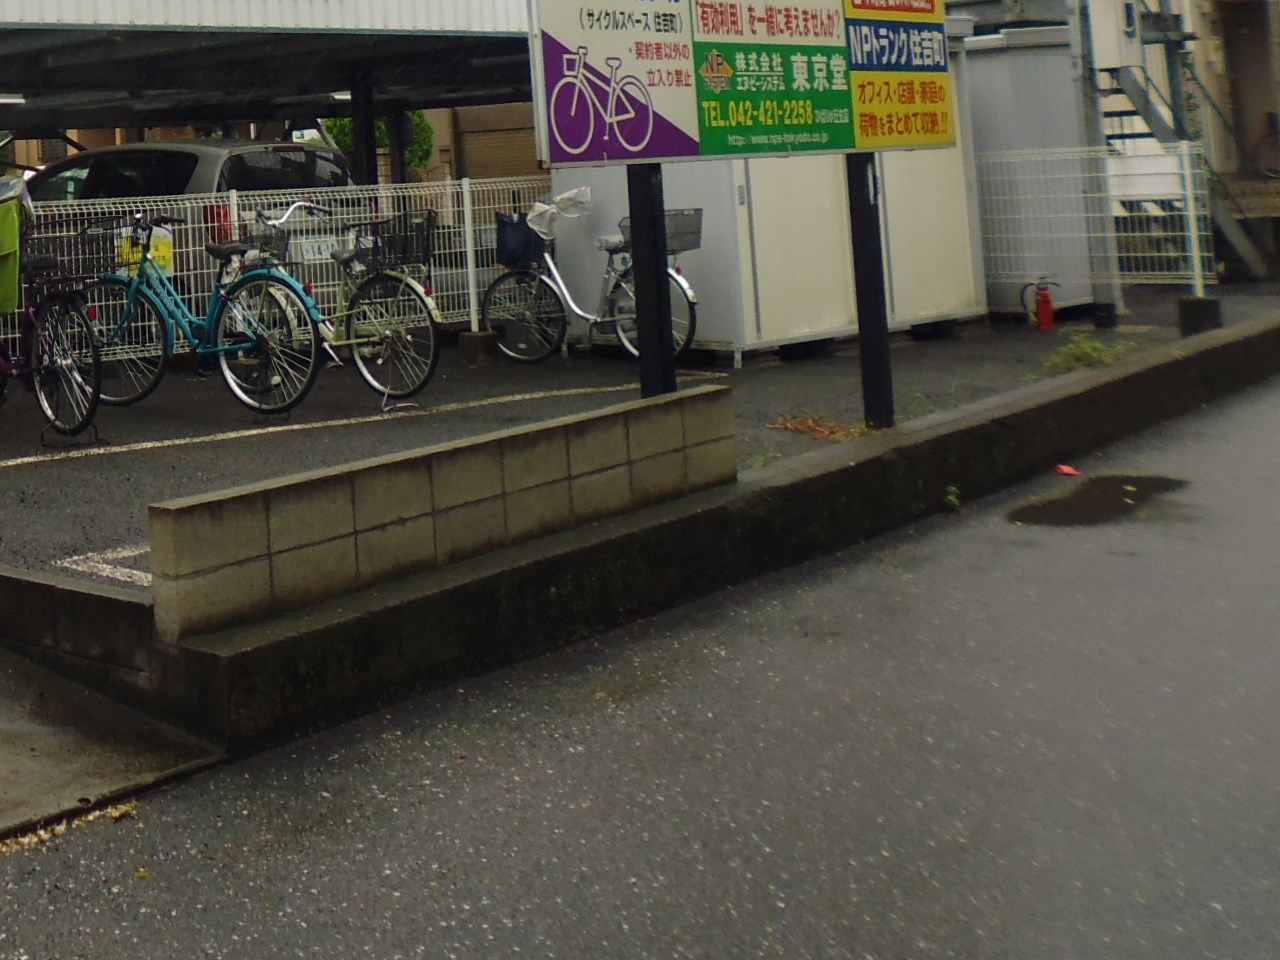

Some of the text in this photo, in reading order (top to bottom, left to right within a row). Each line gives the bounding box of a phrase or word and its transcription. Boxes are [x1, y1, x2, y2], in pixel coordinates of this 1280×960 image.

[646, 68, 693, 88] 立入り禁止
[735, 51, 848, 92] 株式会社 東京堂
[702, 99, 814, 128] TEL.042-421-2258
